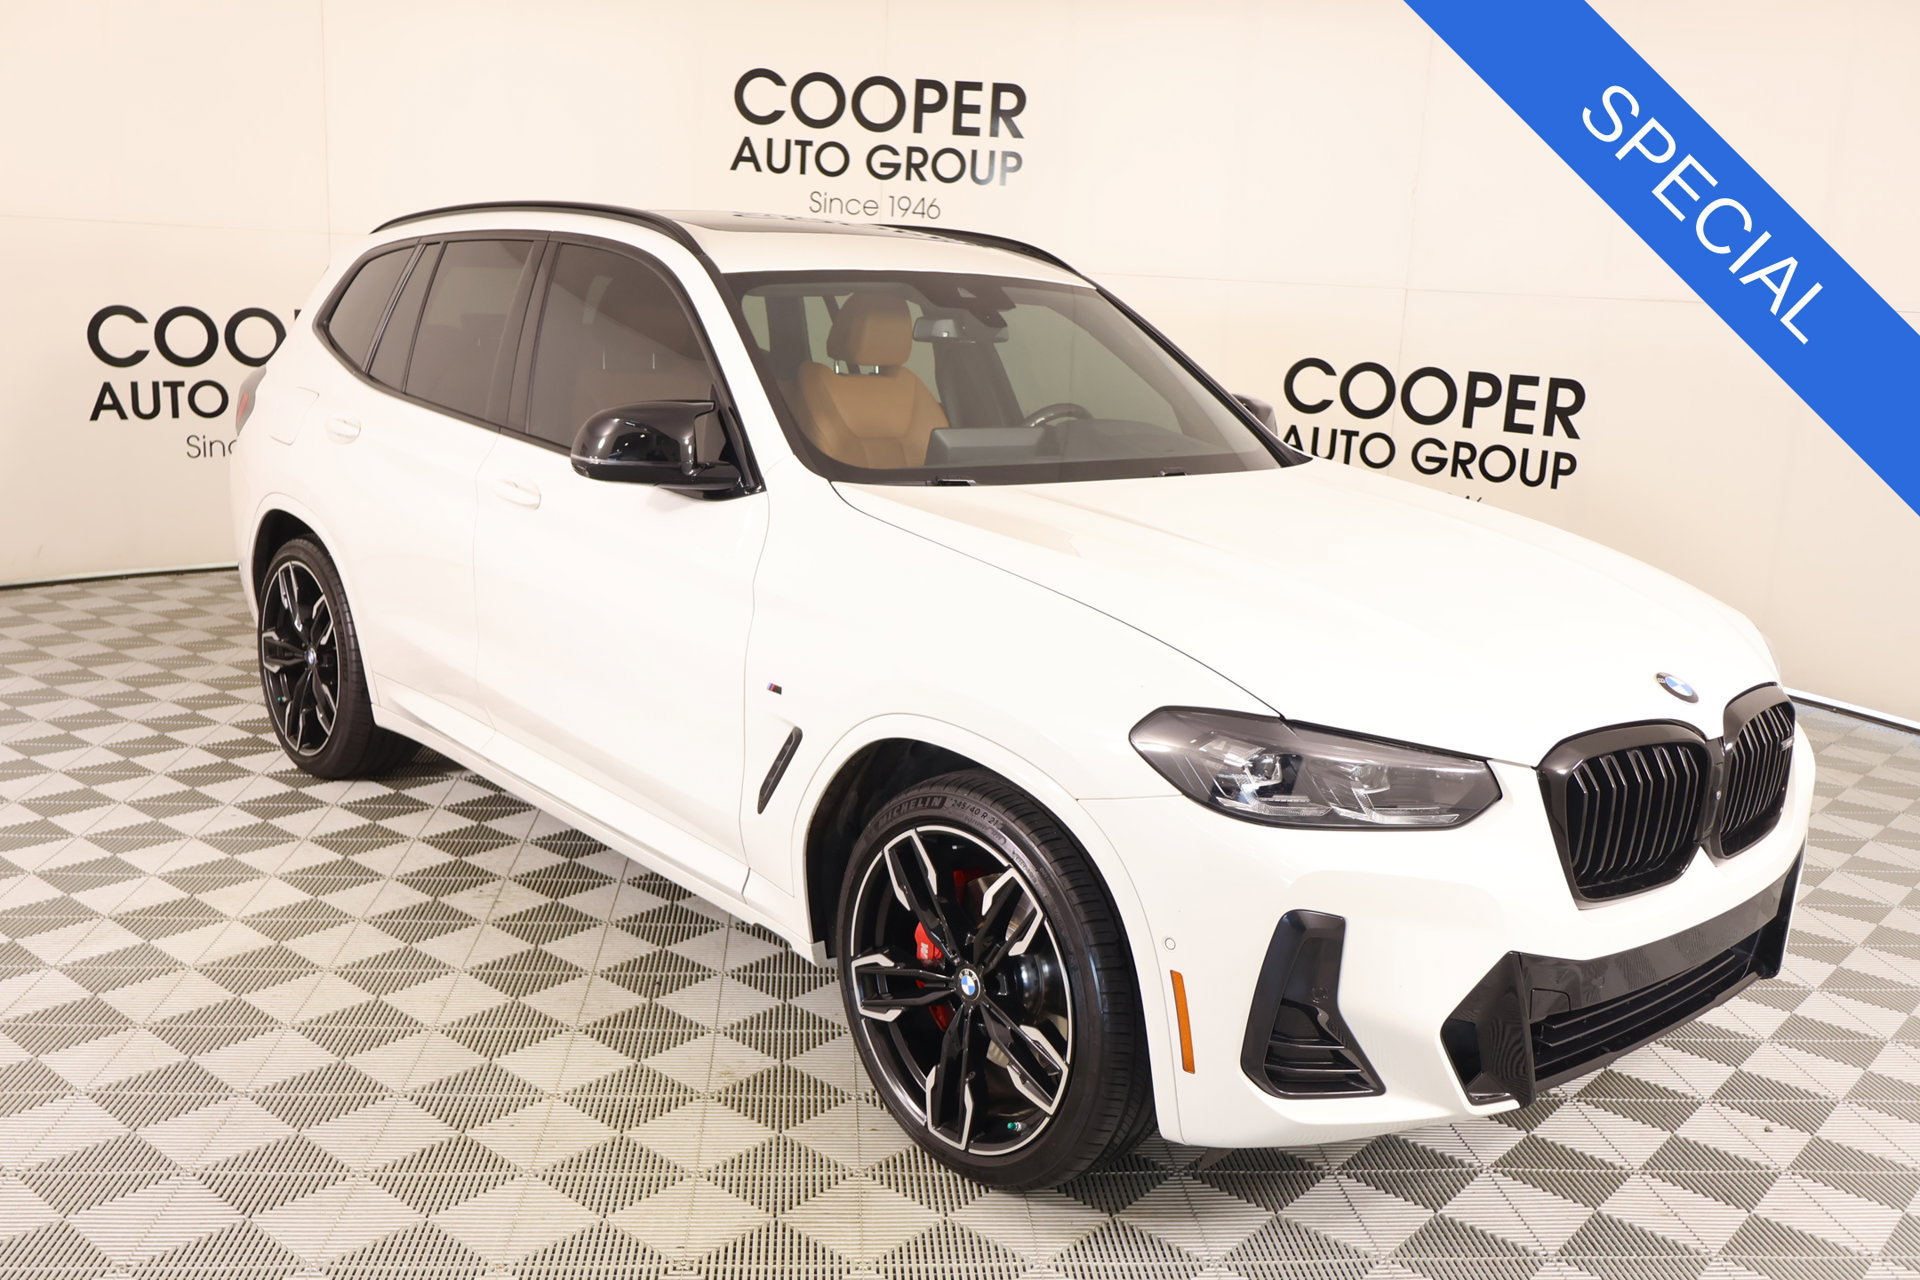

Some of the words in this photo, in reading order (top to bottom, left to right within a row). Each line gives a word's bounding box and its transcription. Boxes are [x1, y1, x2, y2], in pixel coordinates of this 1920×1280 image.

[734, 67, 1027, 139] COOPER
[730, 136, 850, 178] AUTO
[866, 144, 1023, 186] GROUP
[809, 190, 879, 217] Since
[888, 195, 941, 220] 1946
[87, 304, 301, 369] COO
[89, 380, 229, 421] AUTO
[1284, 357, 1586, 440] COOPER
[1283, 424, 1397, 470] AUTO
[1411, 437, 1578, 490] GROUP
[877, 796, 942, 829] MICHELIN
